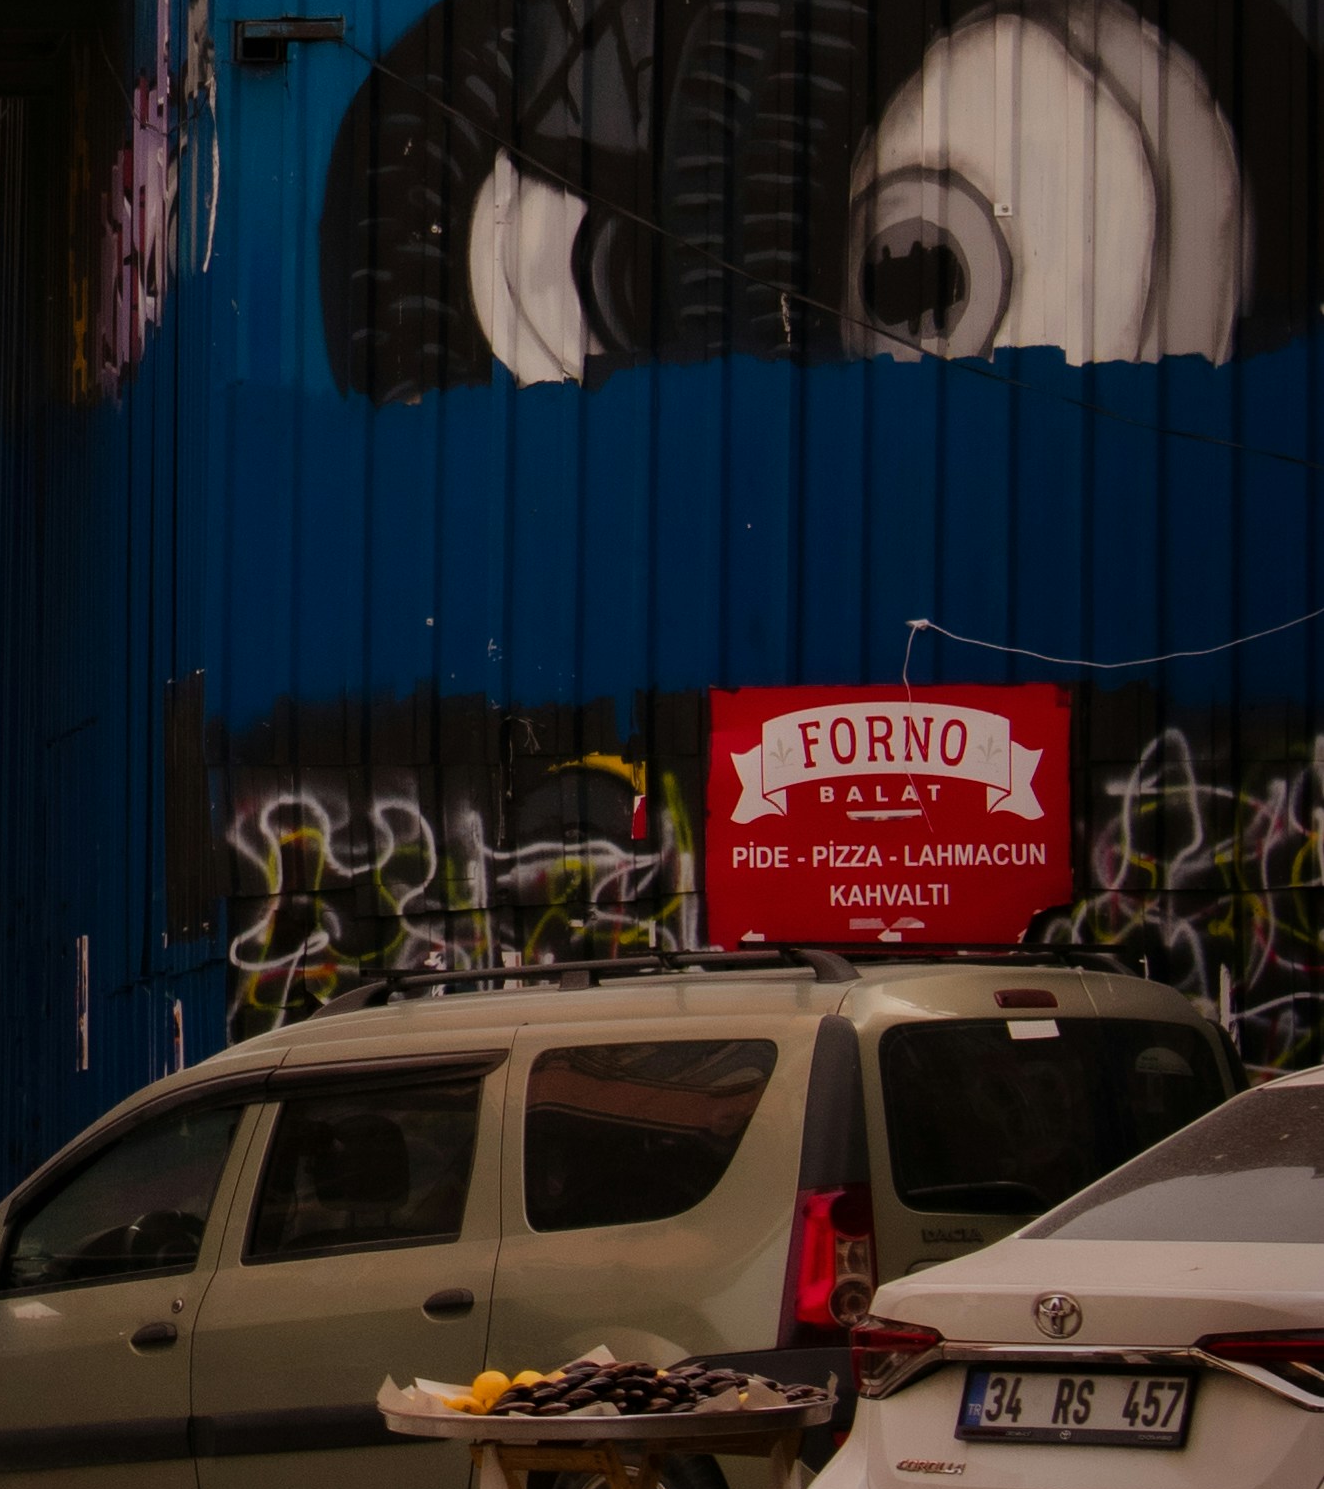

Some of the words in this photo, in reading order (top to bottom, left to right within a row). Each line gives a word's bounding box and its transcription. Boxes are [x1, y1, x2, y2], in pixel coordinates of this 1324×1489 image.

[798, 715, 968, 769] FORNO
[819, 784, 942, 803] BALAT
[732, 840, 790, 869] PİDE
[812, 839, 883, 868] PİZZA
[904, 842, 1046, 867] LAHMACUN
[829, 883, 951, 907] KAHVALTI
[921, 1228, 985, 1243] DACIA
[968, 1403, 982, 1417] TR
[984, 1376, 1023, 1423] 34
[1051, 1378, 1095, 1425] RS
[1121, 1380, 1185, 1428] 457
[896, 1459, 966, 1475] COROLLA
